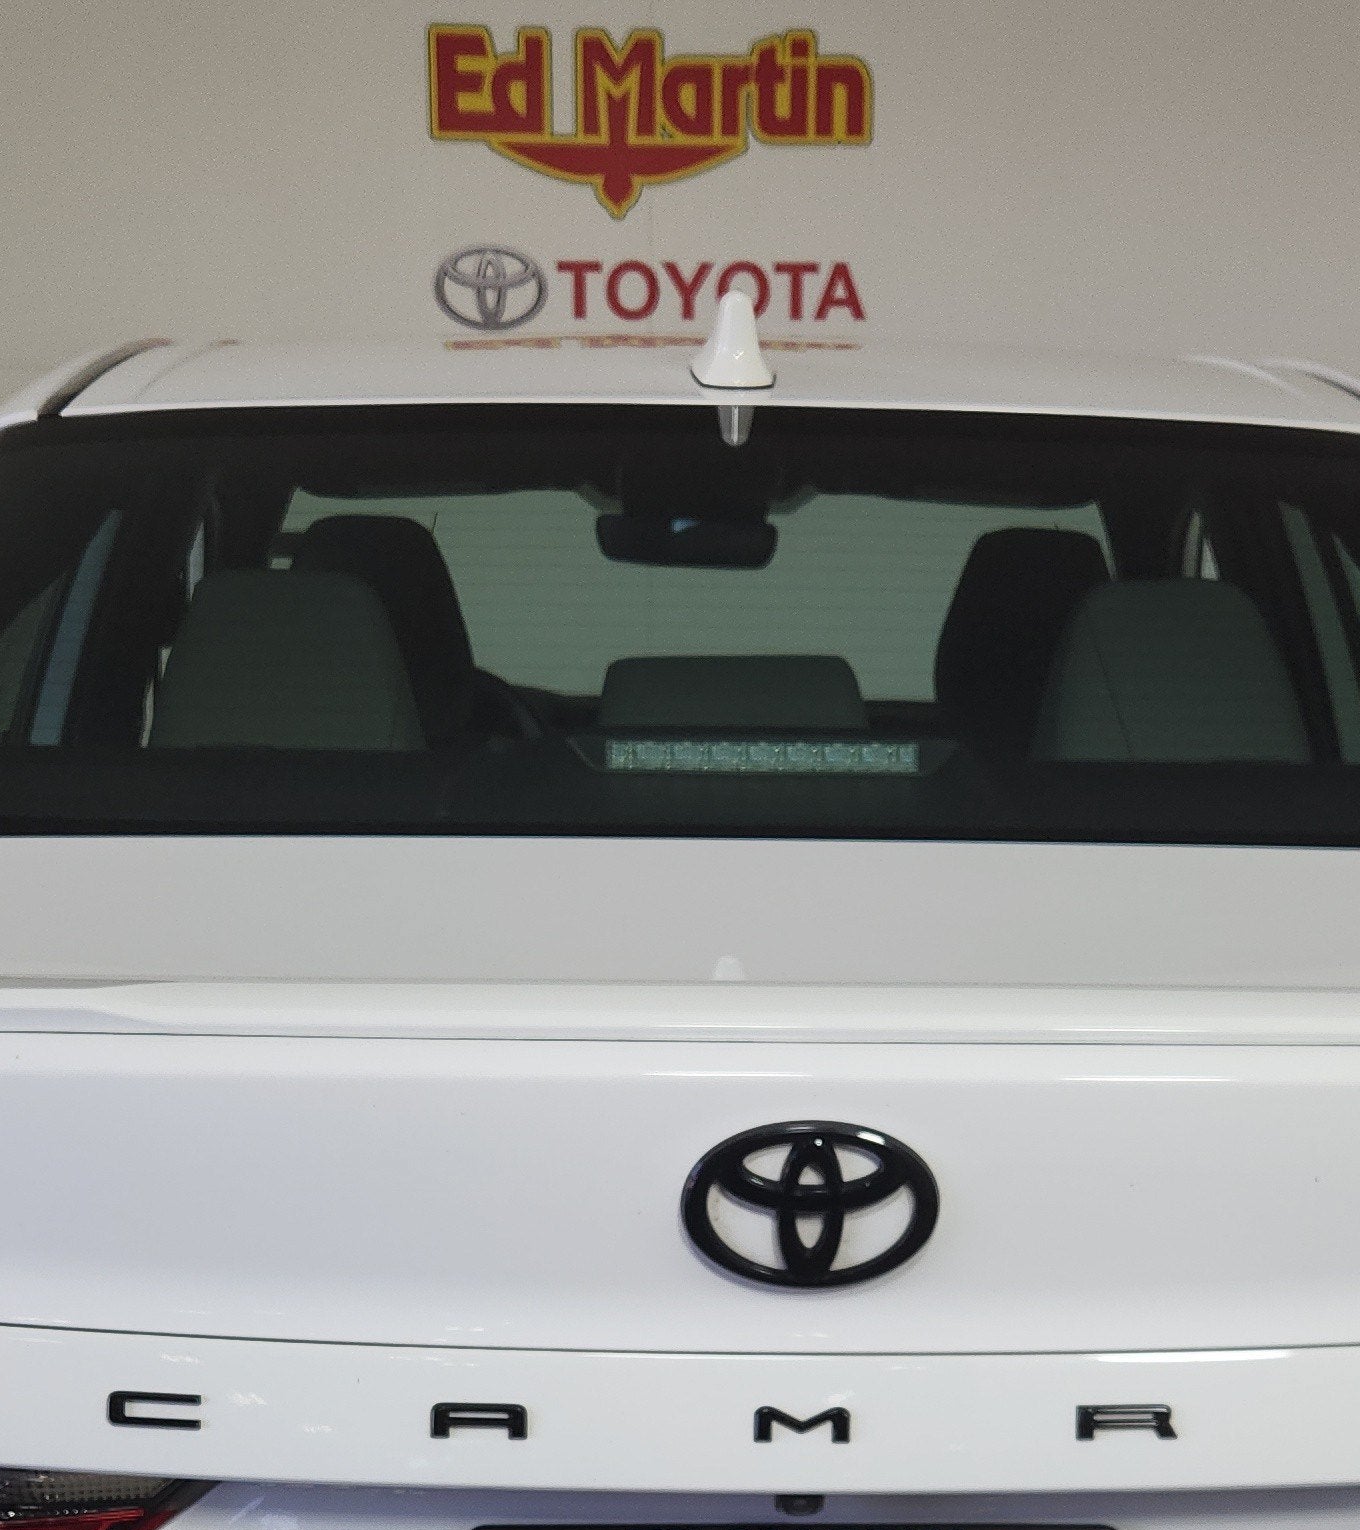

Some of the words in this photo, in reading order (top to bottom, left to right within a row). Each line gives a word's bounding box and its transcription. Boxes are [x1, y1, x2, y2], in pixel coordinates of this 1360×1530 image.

[429, 23, 551, 140] Ed
[575, 27, 874, 146] Martin
[557, 260, 867, 321] TOYOTA
